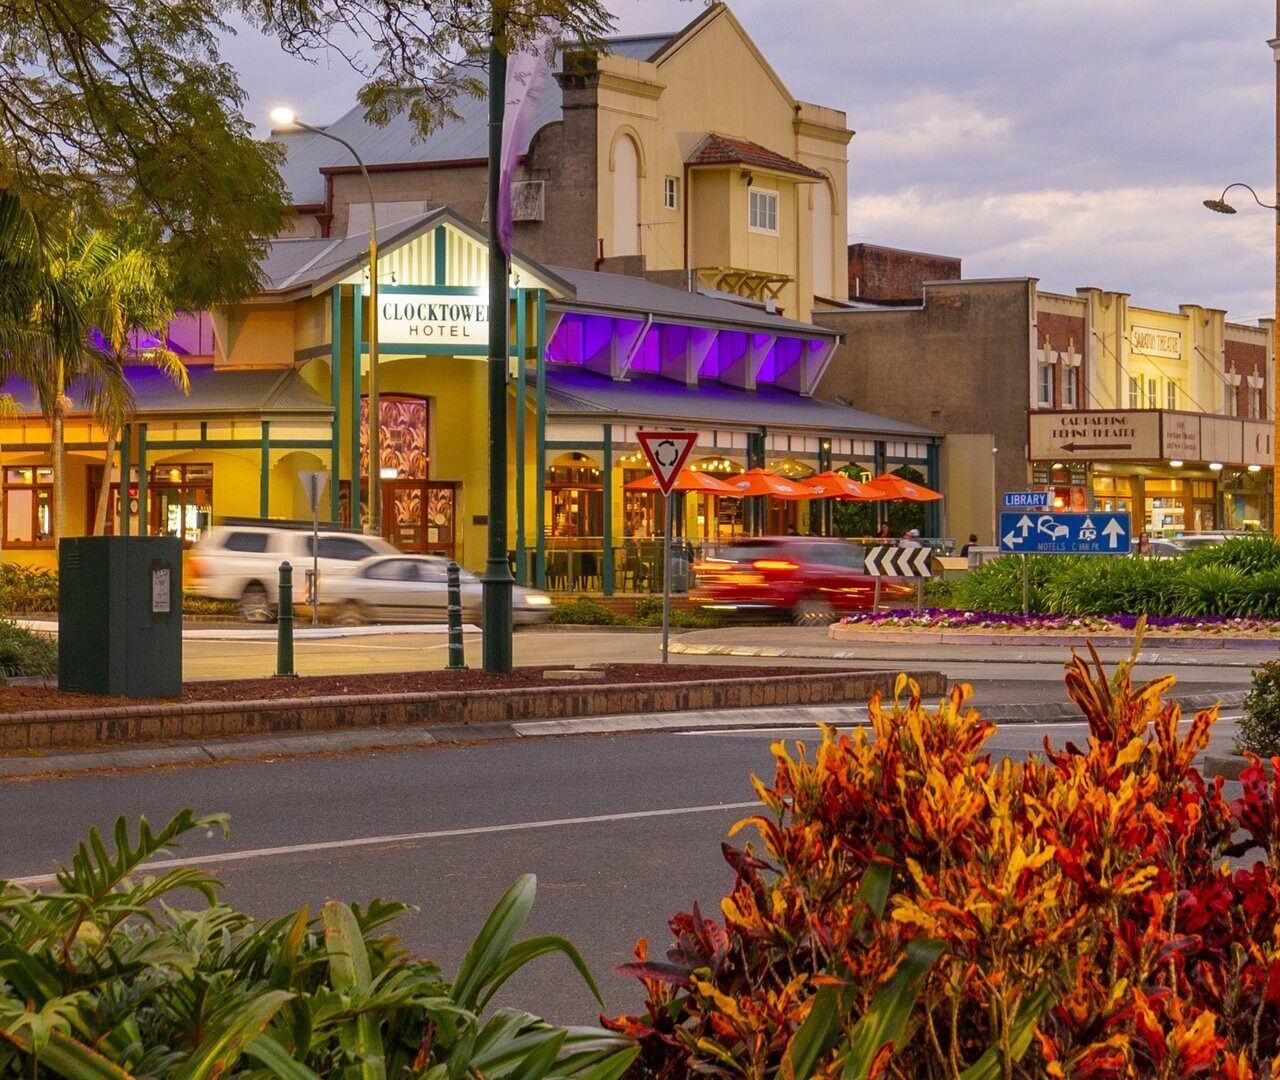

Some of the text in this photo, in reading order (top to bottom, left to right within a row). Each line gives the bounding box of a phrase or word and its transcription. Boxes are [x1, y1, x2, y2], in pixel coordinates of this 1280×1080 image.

[409, 324, 470, 337] HOTEL
[1061, 415, 1129, 426] CAR PARKING
[1052, 428, 1137, 439] BEHIND THEATRE
[1005, 493, 1046, 506] LIBRARY
[1037, 542, 1066, 551] MOTELS
